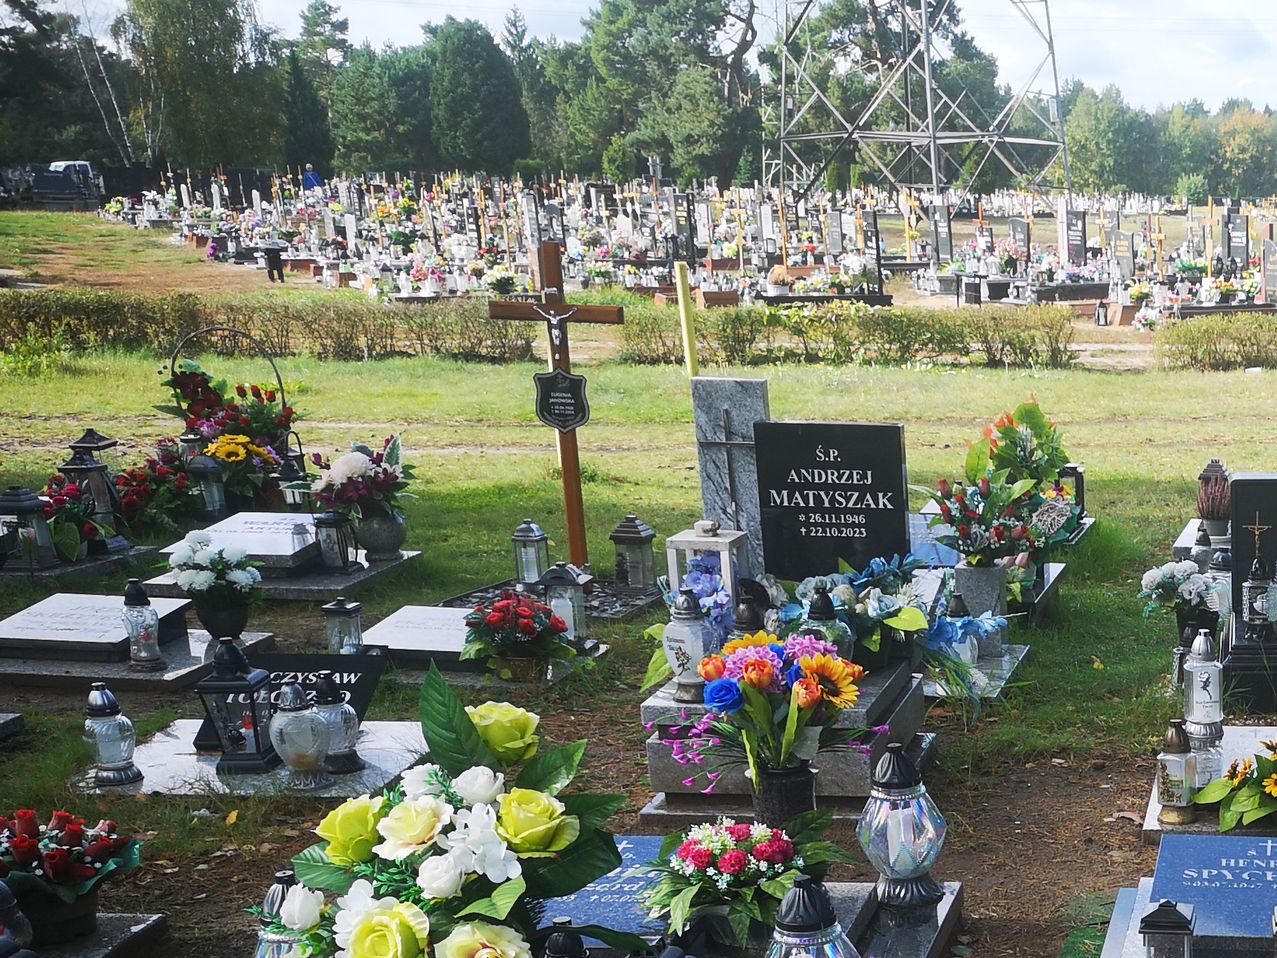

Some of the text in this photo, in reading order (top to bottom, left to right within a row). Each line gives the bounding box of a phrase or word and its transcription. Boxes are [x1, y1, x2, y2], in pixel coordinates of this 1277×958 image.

[815, 445, 841, 462] Ś.P.
[787, 469, 873, 485] ANDRZEJ
[769, 489, 894, 510] MATYSZAK
[809, 513, 866, 524] 26.11.1946
[809, 527, 867, 537] 22.10.2023
